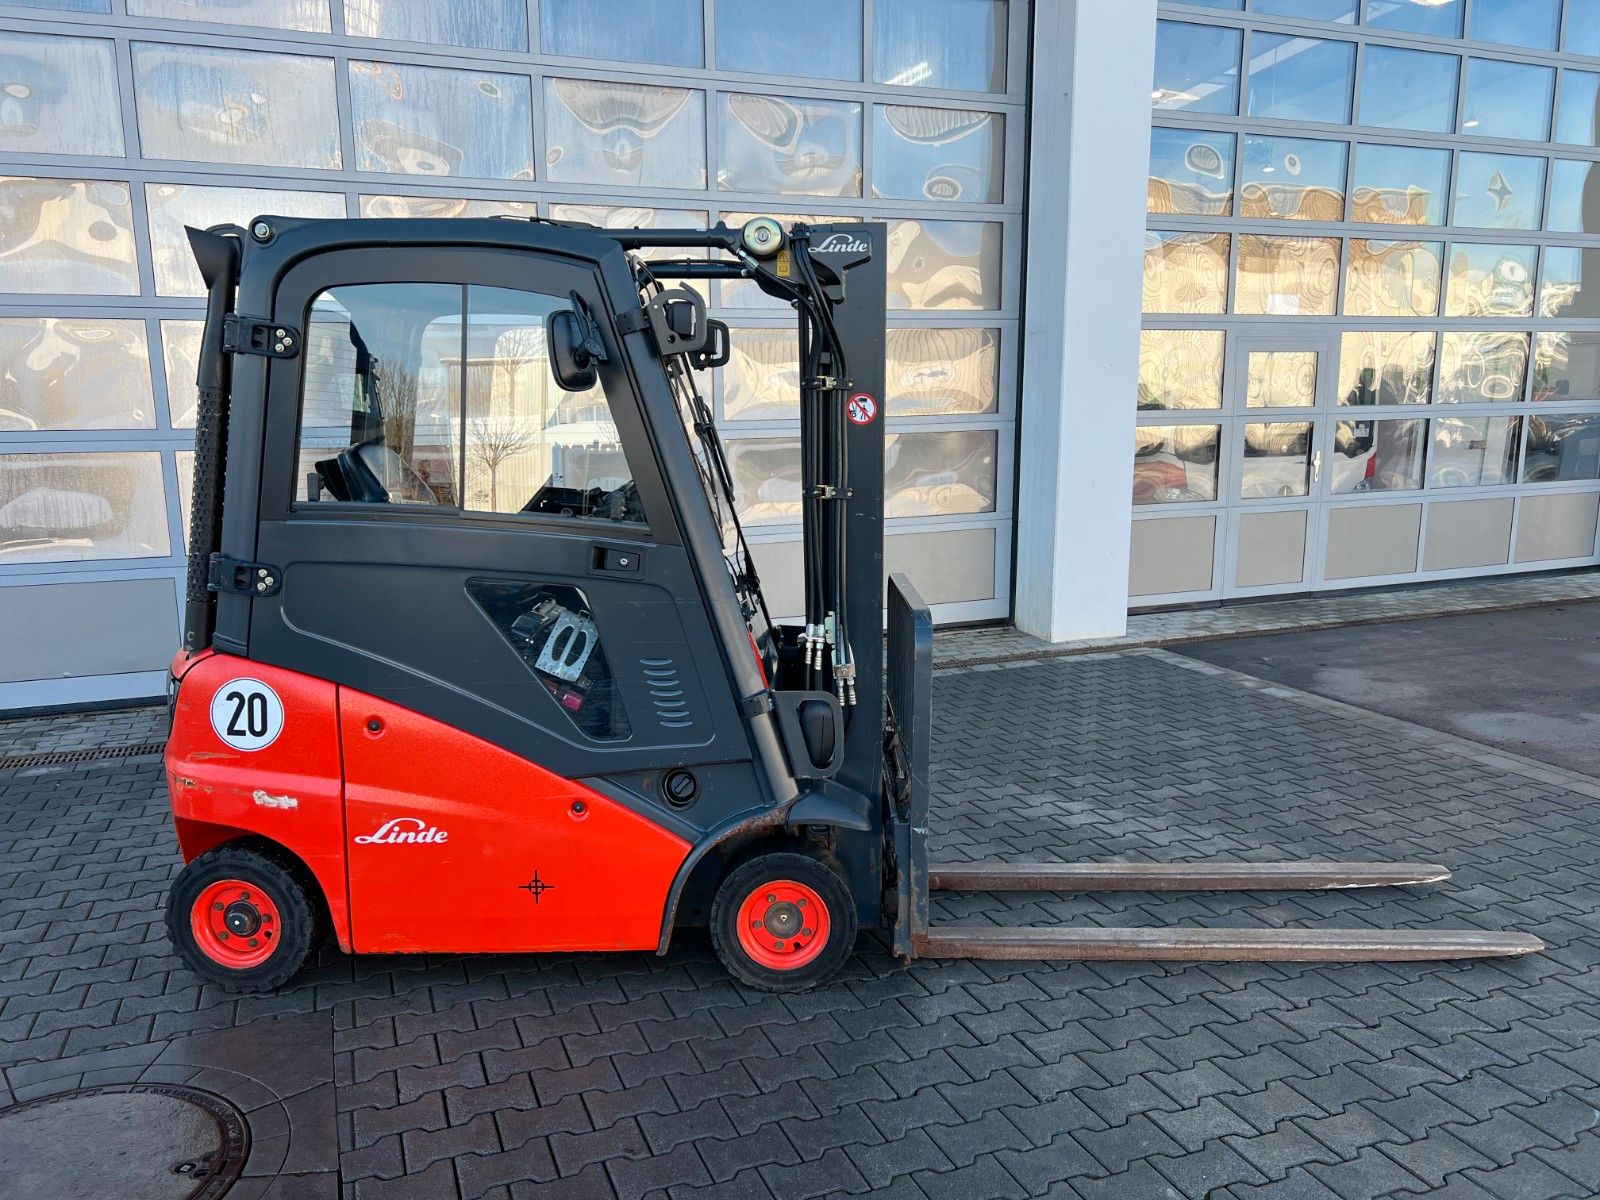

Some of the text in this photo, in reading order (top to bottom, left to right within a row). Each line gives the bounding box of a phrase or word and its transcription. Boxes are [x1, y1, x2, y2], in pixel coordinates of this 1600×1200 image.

[808, 233, 868, 253] Linde
[226, 691, 268, 737] 20
[354, 817, 448, 844] Linde
